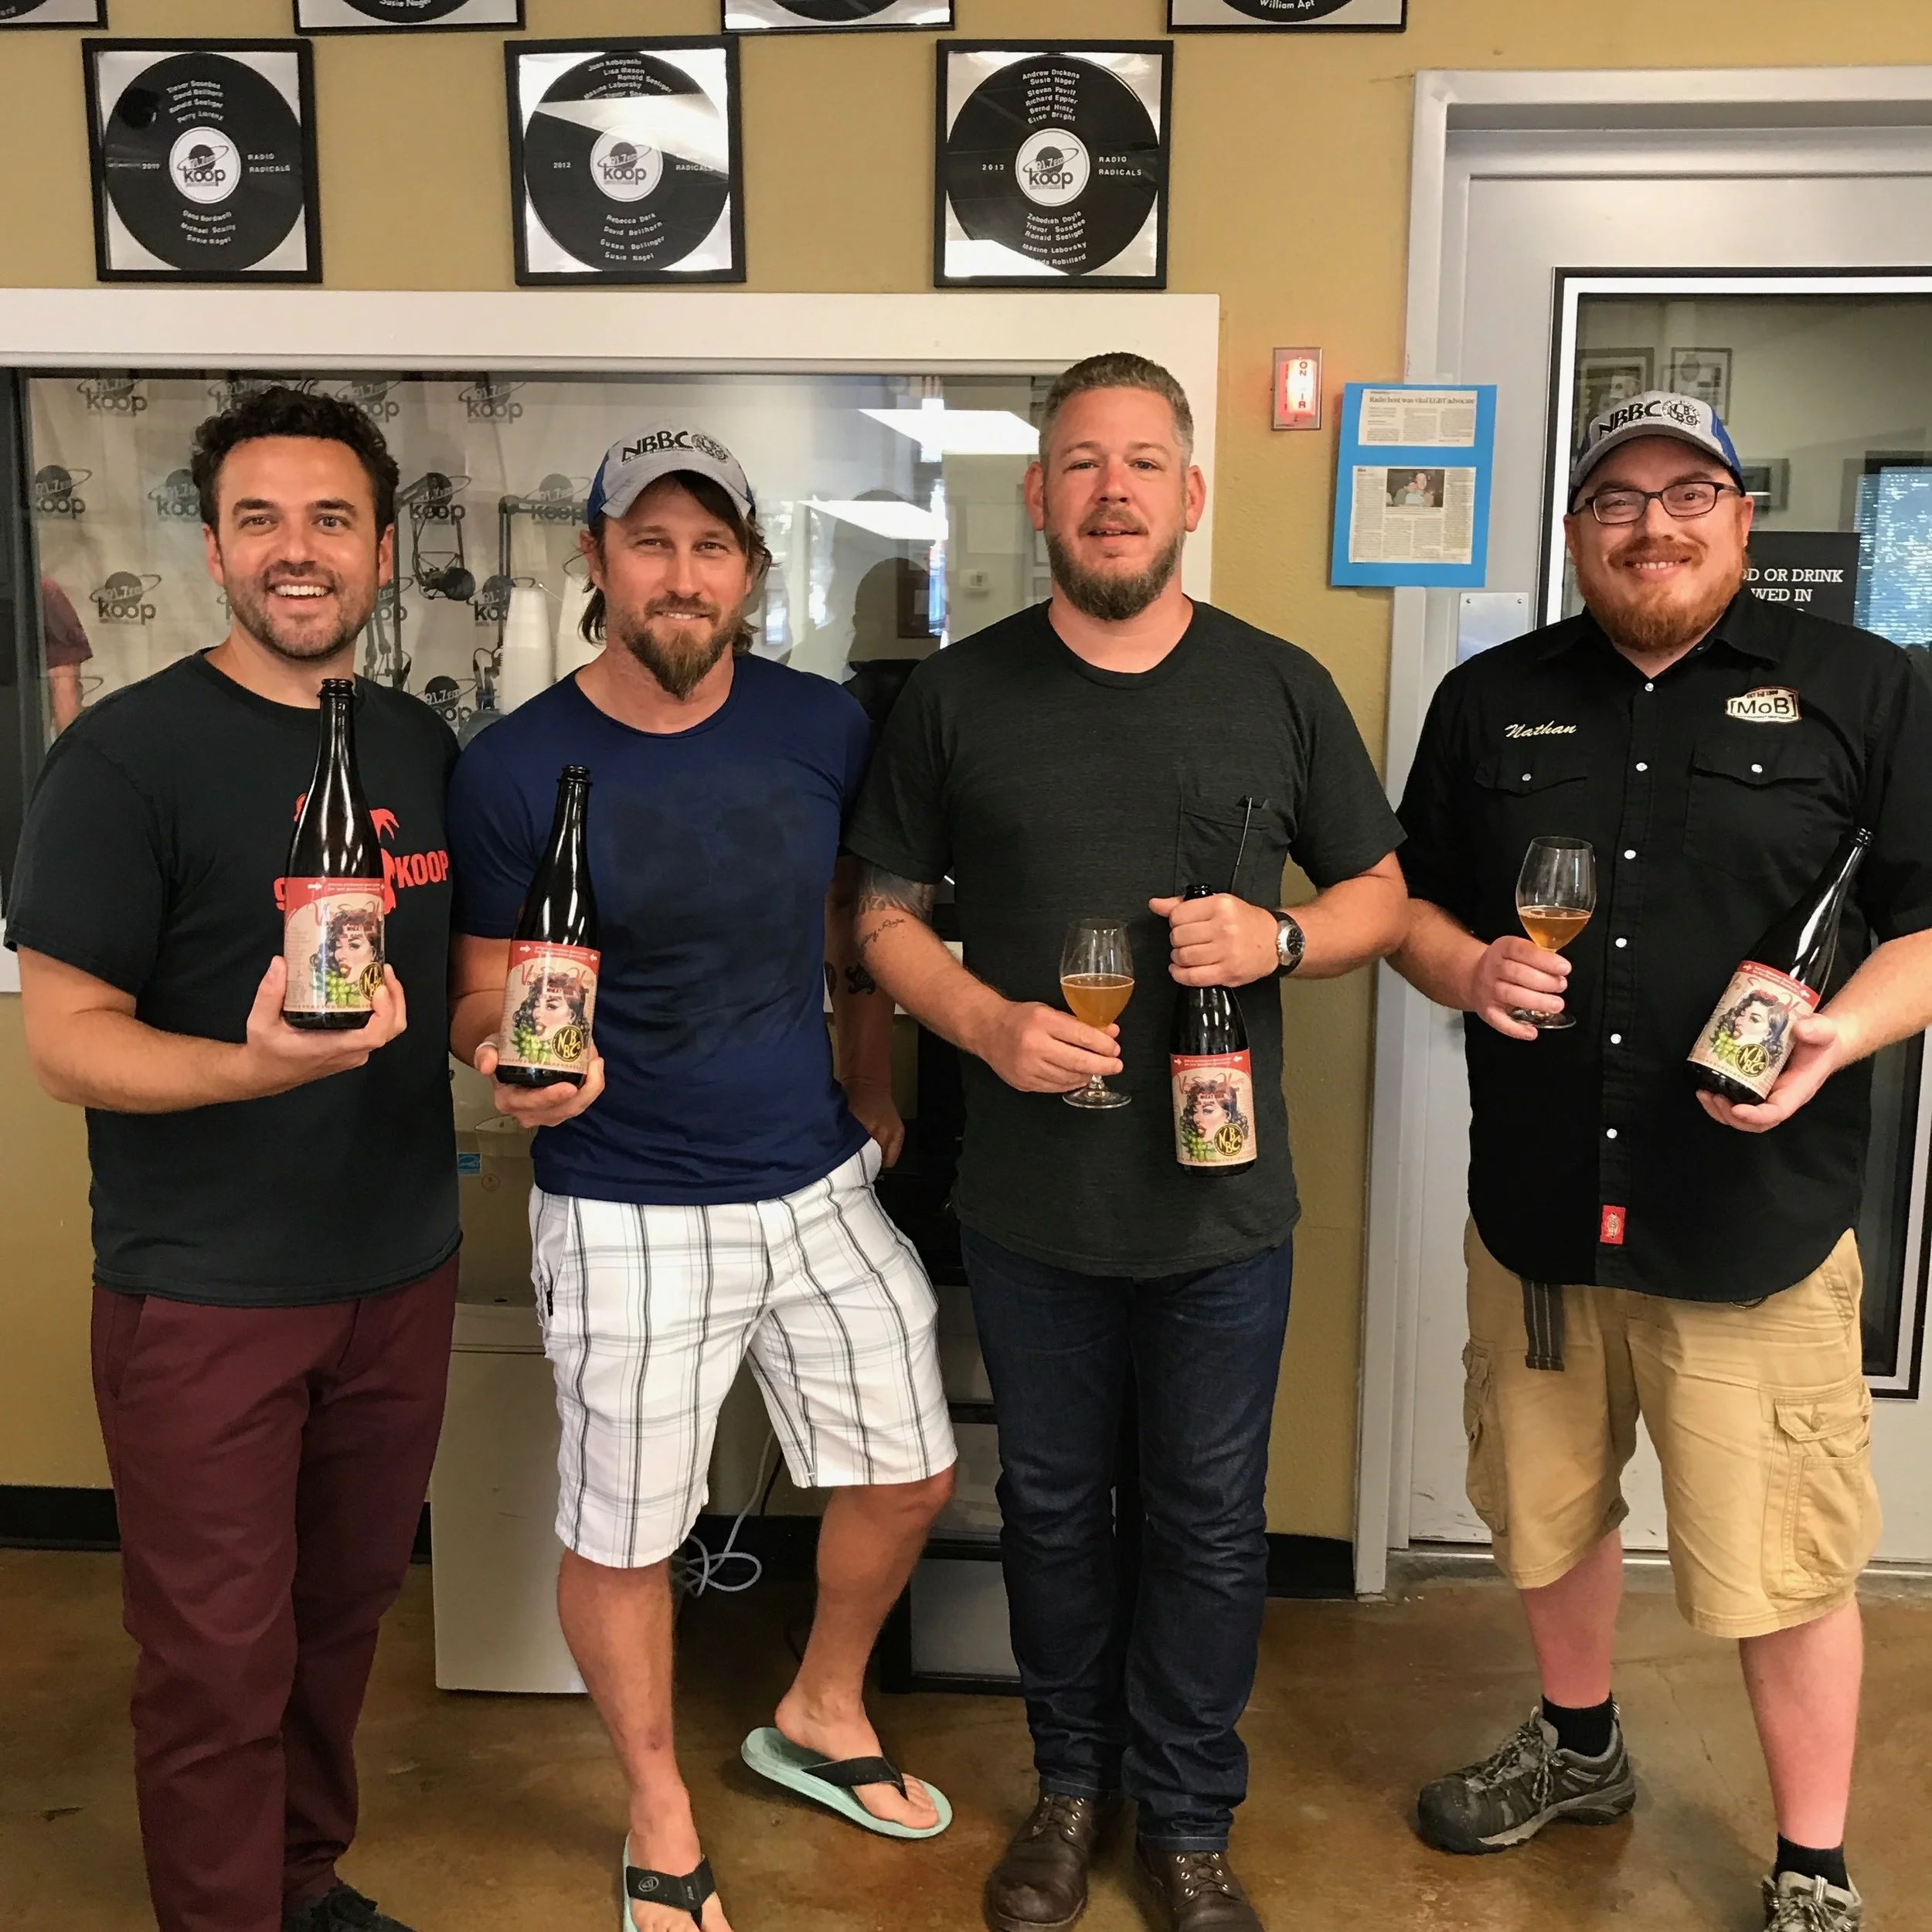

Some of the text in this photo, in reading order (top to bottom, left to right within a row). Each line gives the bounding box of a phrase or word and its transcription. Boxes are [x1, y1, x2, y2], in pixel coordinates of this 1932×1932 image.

[1260, 0, 1315, 10] William Apt
[1022, 69, 1080, 80] Andrew Dickens
[1026, 94, 1053, 107] Richard
[1051, 111, 1076, 121] Bright
[184, 165, 226, 186] koop
[604, 163, 647, 185] koop
[1029, 168, 1073, 189] koop
[1025, 230, 1051, 241] Ronald
[1052, 253, 1087, 265] Robillard
[1299, 361, 1308, 376] ON
[86, 387, 148, 418] koop
[467, 396, 523, 424] koop
[1599, 400, 1662, 440] NBBC
[621, 430, 694, 462] NBBC
[156, 495, 199, 516] koo
[1764, 568, 1788, 582] OR
[1791, 569, 1844, 583] DRINK
[1794, 588, 1813, 602] IN
[98, 596, 156, 625] koop
[1504, 720, 1577, 739] Nathan
[394, 850, 449, 889] KOOP
